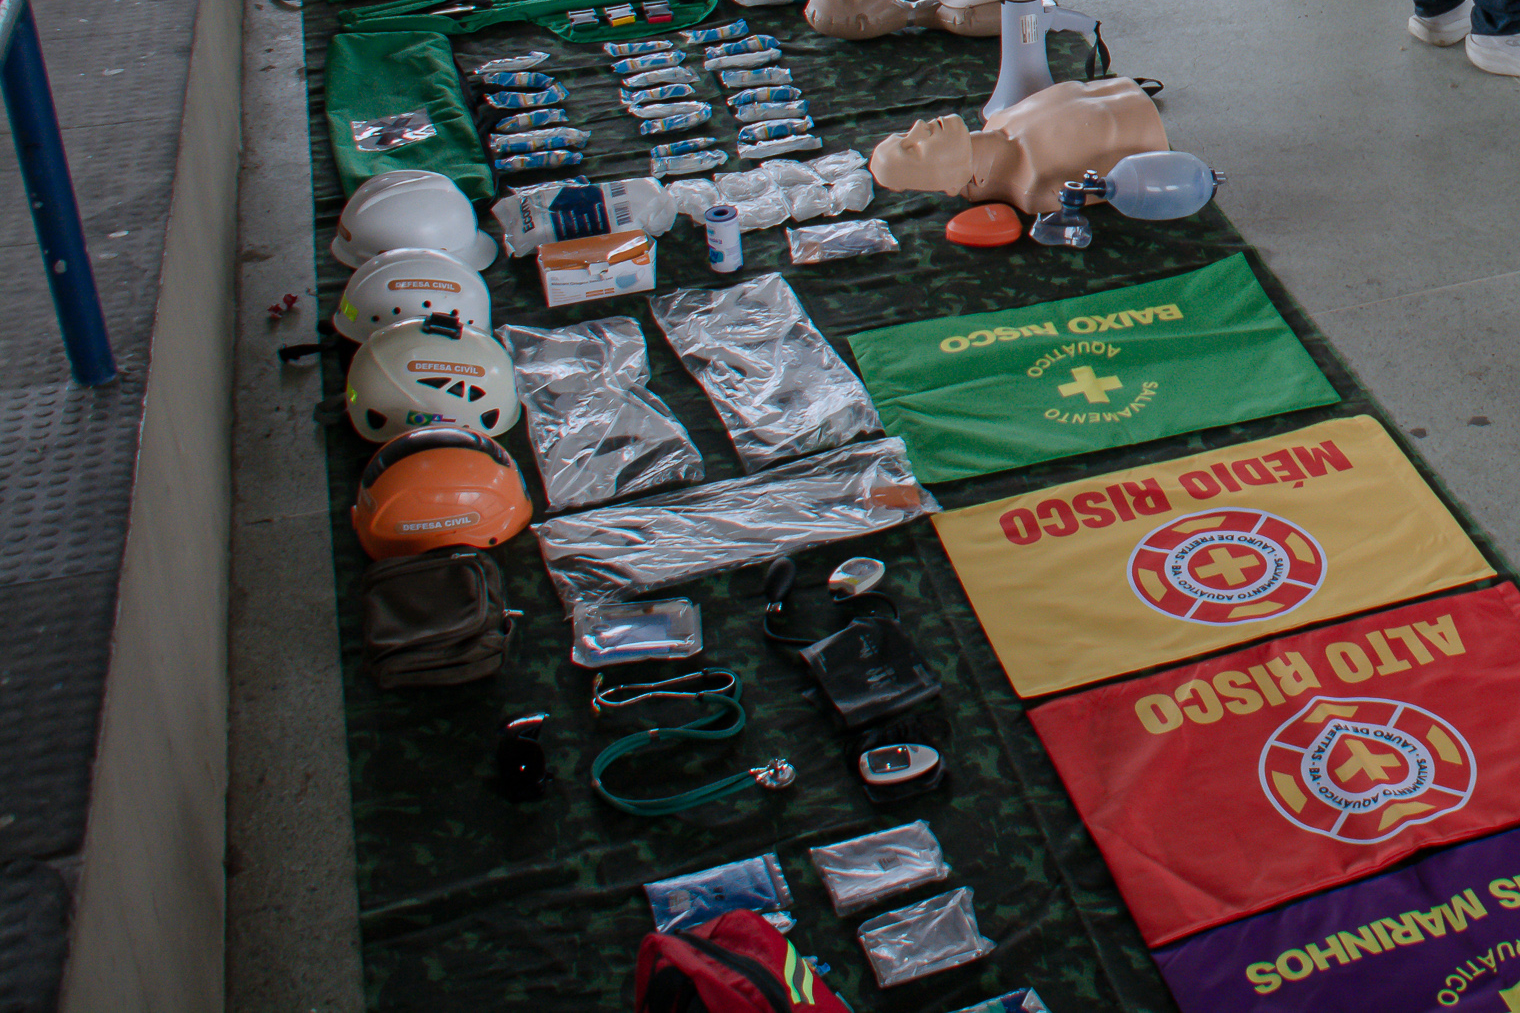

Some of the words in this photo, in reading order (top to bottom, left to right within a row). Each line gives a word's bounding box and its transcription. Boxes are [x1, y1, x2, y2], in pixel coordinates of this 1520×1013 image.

[395, 280, 428, 290] DEFESA
[429, 282, 455, 291] CIVIL
[1067, 303, 1184, 335] BAIXO
[940, 320, 1060, 354] RISCO
[415, 362, 452, 373] DEFESA
[454, 364, 479, 375] CIVIL
[1027, 341, 1122, 379] AQUÁTICO
[1044, 380, 1160, 425] SALVAMENTO
[1179, 440, 1354, 501] MÉDIO
[402, 520, 442, 532] DEFESA
[444, 516, 472, 528] CIVIL
[999, 476, 1173, 546] RISCO
[1174, 535, 1216, 561] FREITAS
[1217, 534, 1235, 542] DE
[1238, 534, 1276, 556] LAURO
[1237, 557, 1284, 600] SALVAMENTO
[1325, 613, 1467, 684] ALTO
[1134, 651, 1323, 735] RISCO
[1352, 725, 1370, 735] DE
[1373, 729, 1418, 754] LAURO
[1382, 758, 1428, 797] SALVAMENTO
[1245, 889, 1489, 995] MARINHOS
